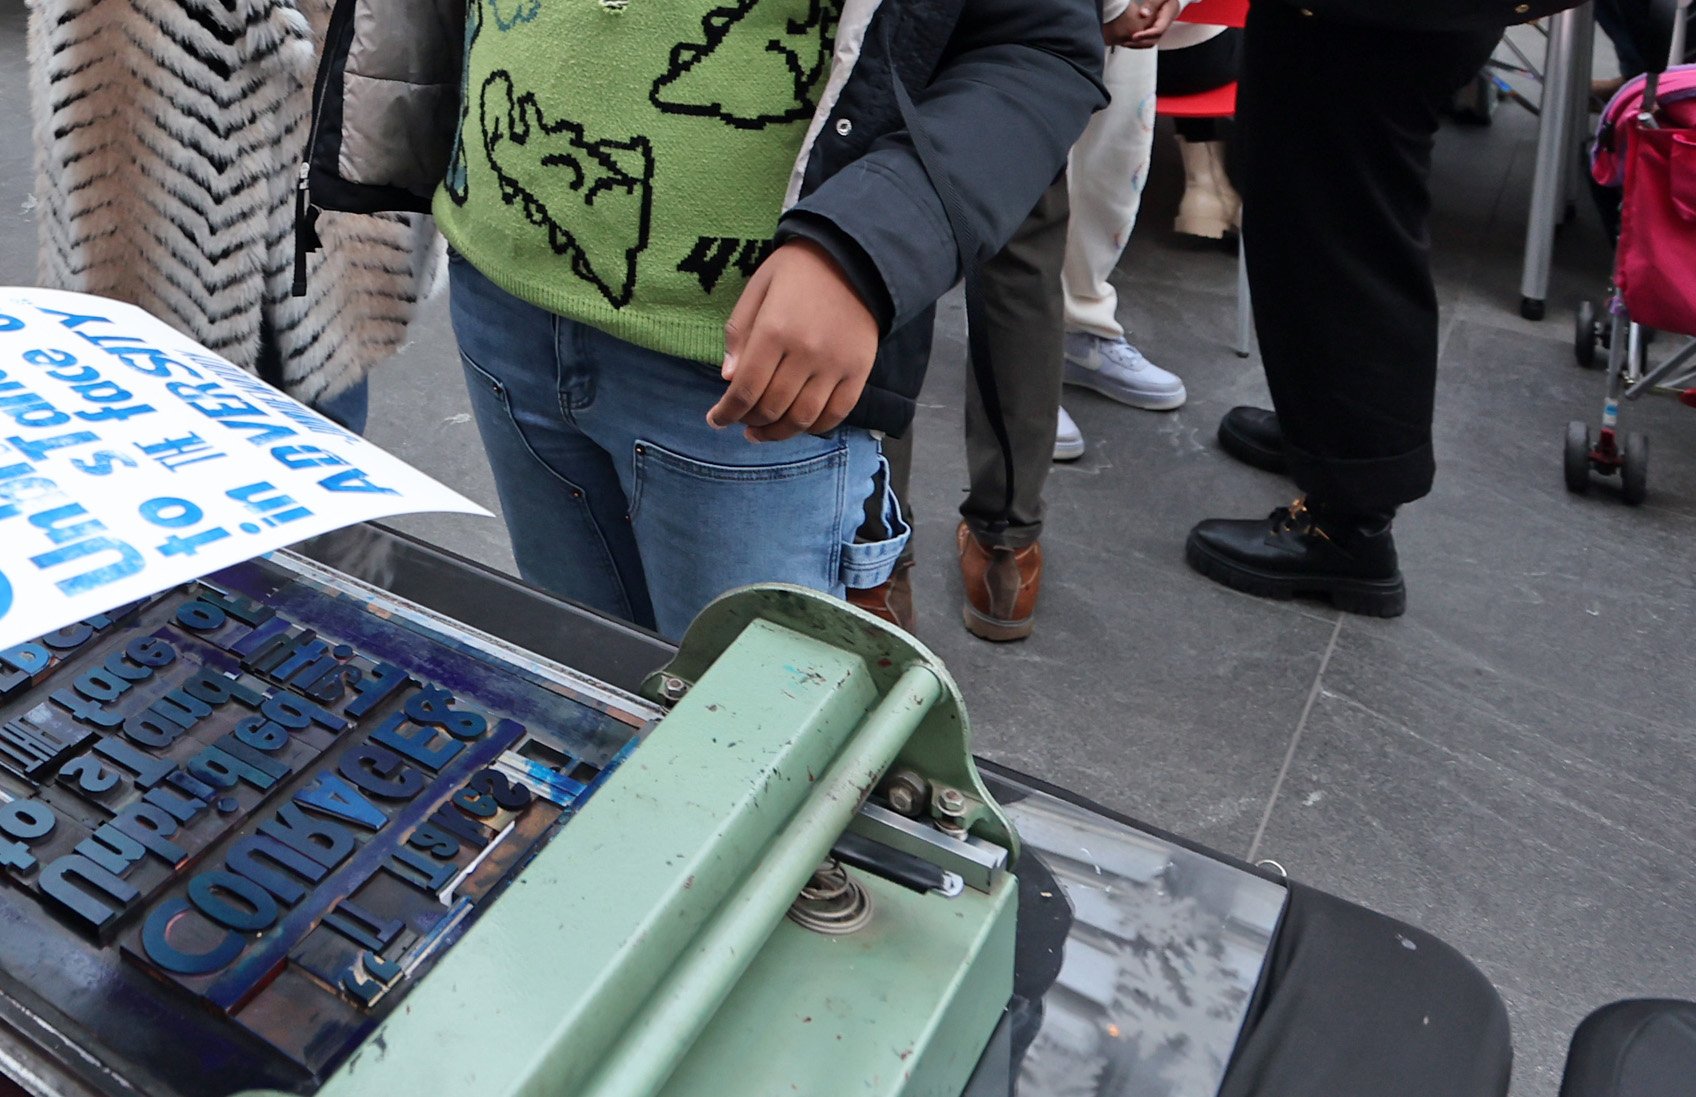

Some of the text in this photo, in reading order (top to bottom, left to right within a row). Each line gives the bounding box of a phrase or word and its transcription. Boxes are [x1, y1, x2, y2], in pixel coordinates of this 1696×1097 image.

[23, 349, 157, 422] face
[133, 431, 227, 472] THE
[139, 497, 231, 557] to
[226, 481, 314, 534] in
